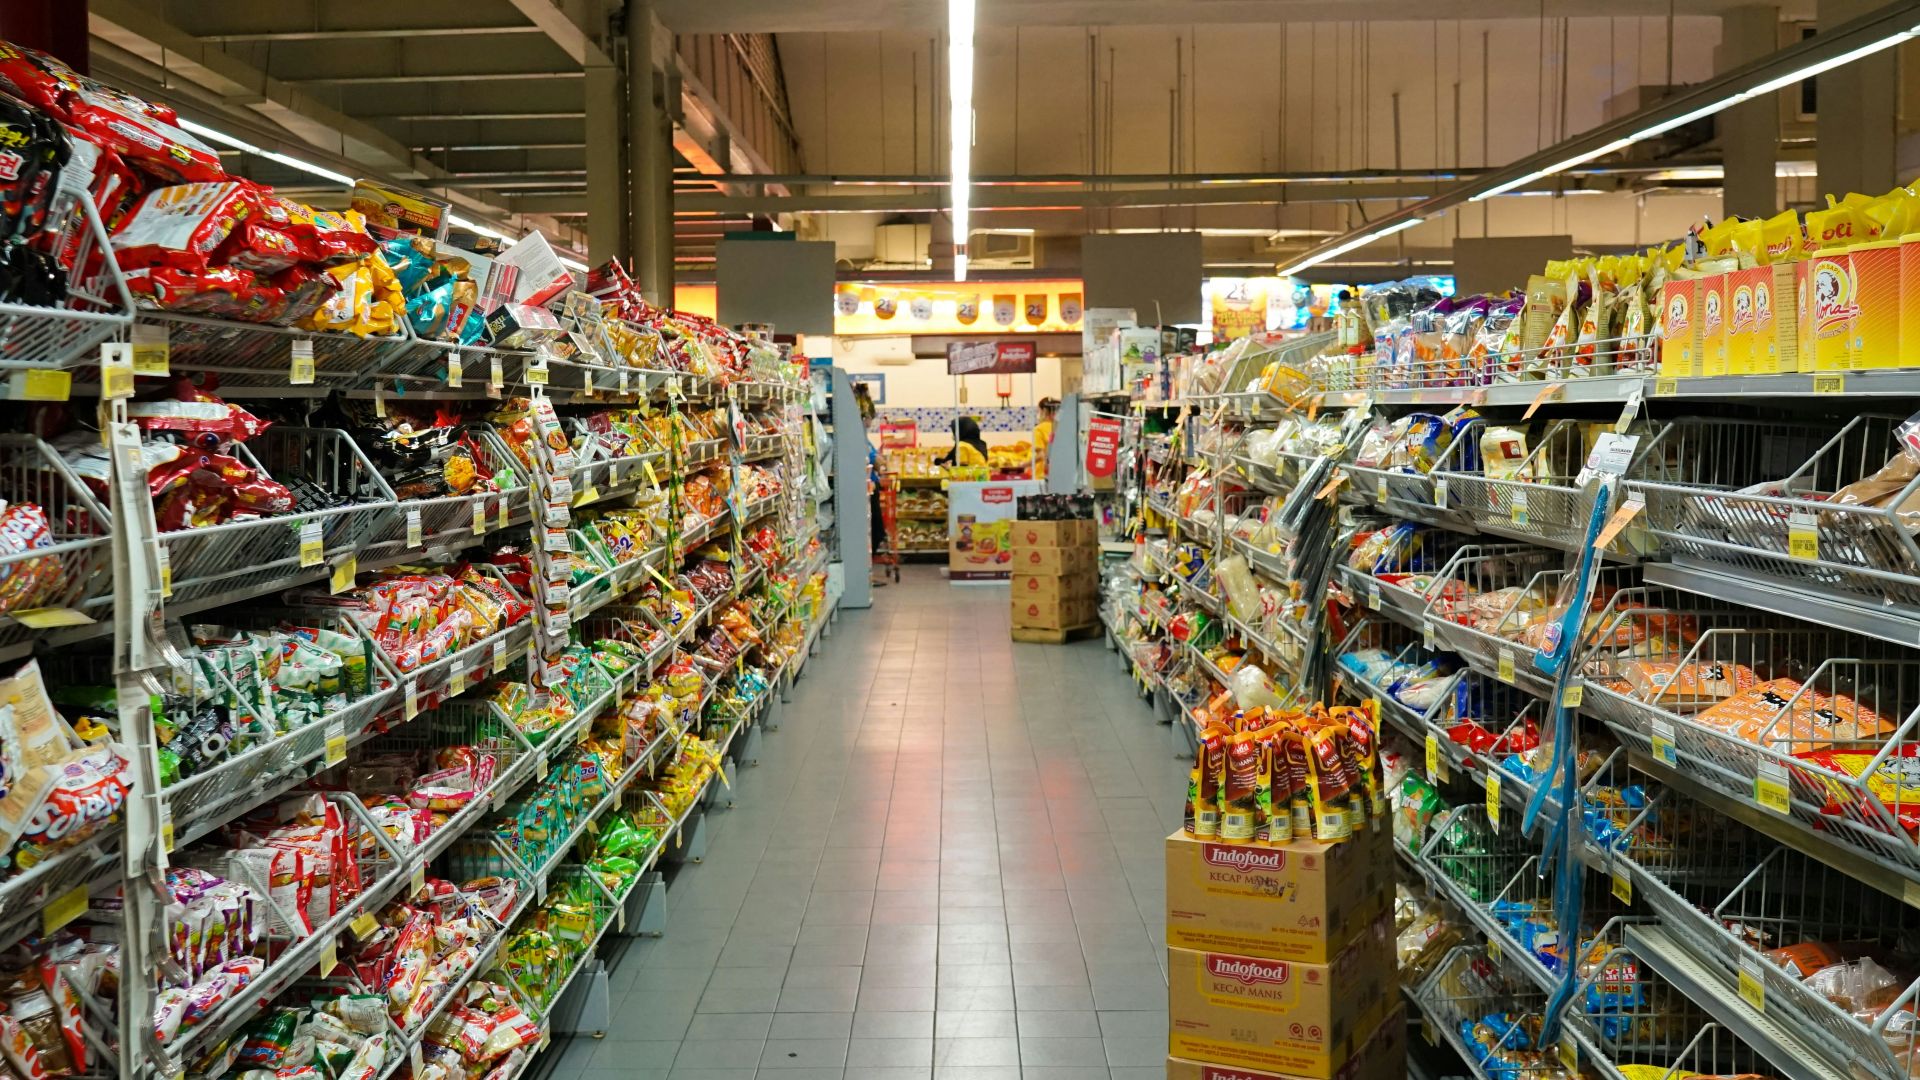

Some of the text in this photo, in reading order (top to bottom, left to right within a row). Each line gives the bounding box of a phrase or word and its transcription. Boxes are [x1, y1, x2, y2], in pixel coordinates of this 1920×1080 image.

[1211, 848, 1280, 868] Indofood
[1210, 872, 1242, 883] KECAP
[1214, 959, 1283, 980] Indofood
[1213, 983, 1283, 1000] KECAP MANIS
